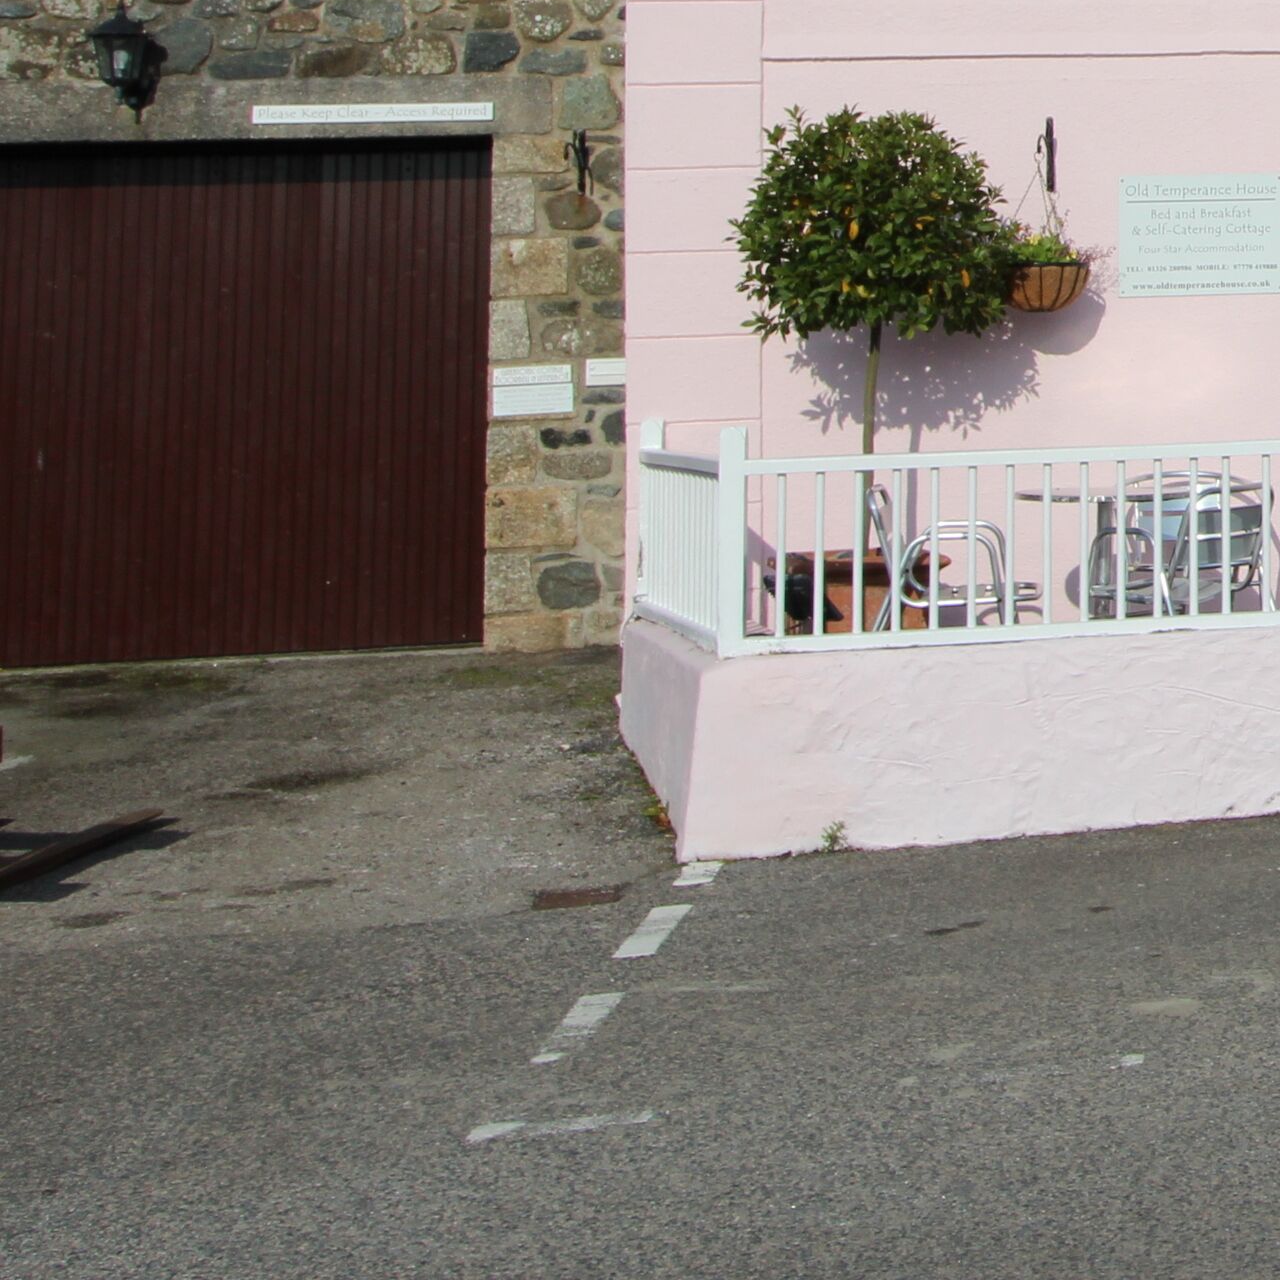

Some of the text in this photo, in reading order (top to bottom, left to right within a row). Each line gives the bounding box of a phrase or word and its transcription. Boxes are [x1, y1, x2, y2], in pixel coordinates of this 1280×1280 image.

[258, 107, 297, 119] Please
[302, 107, 333, 121] Keep
[337, 105, 369, 118] Clear
[384, 106, 427, 118] Access
[431, 104, 487, 120] Required
[1125, 183, 1277, 198] Old Temperance House
[1150, 205, 1252, 220] Bed and Breakfast
[1131, 223, 1271, 237] & Self-Catering Cottage
[1138, 243, 1265, 255] Four Star Accommodation
[1132, 280, 1271, 291] www.oldtemperancehouse.co.uk
